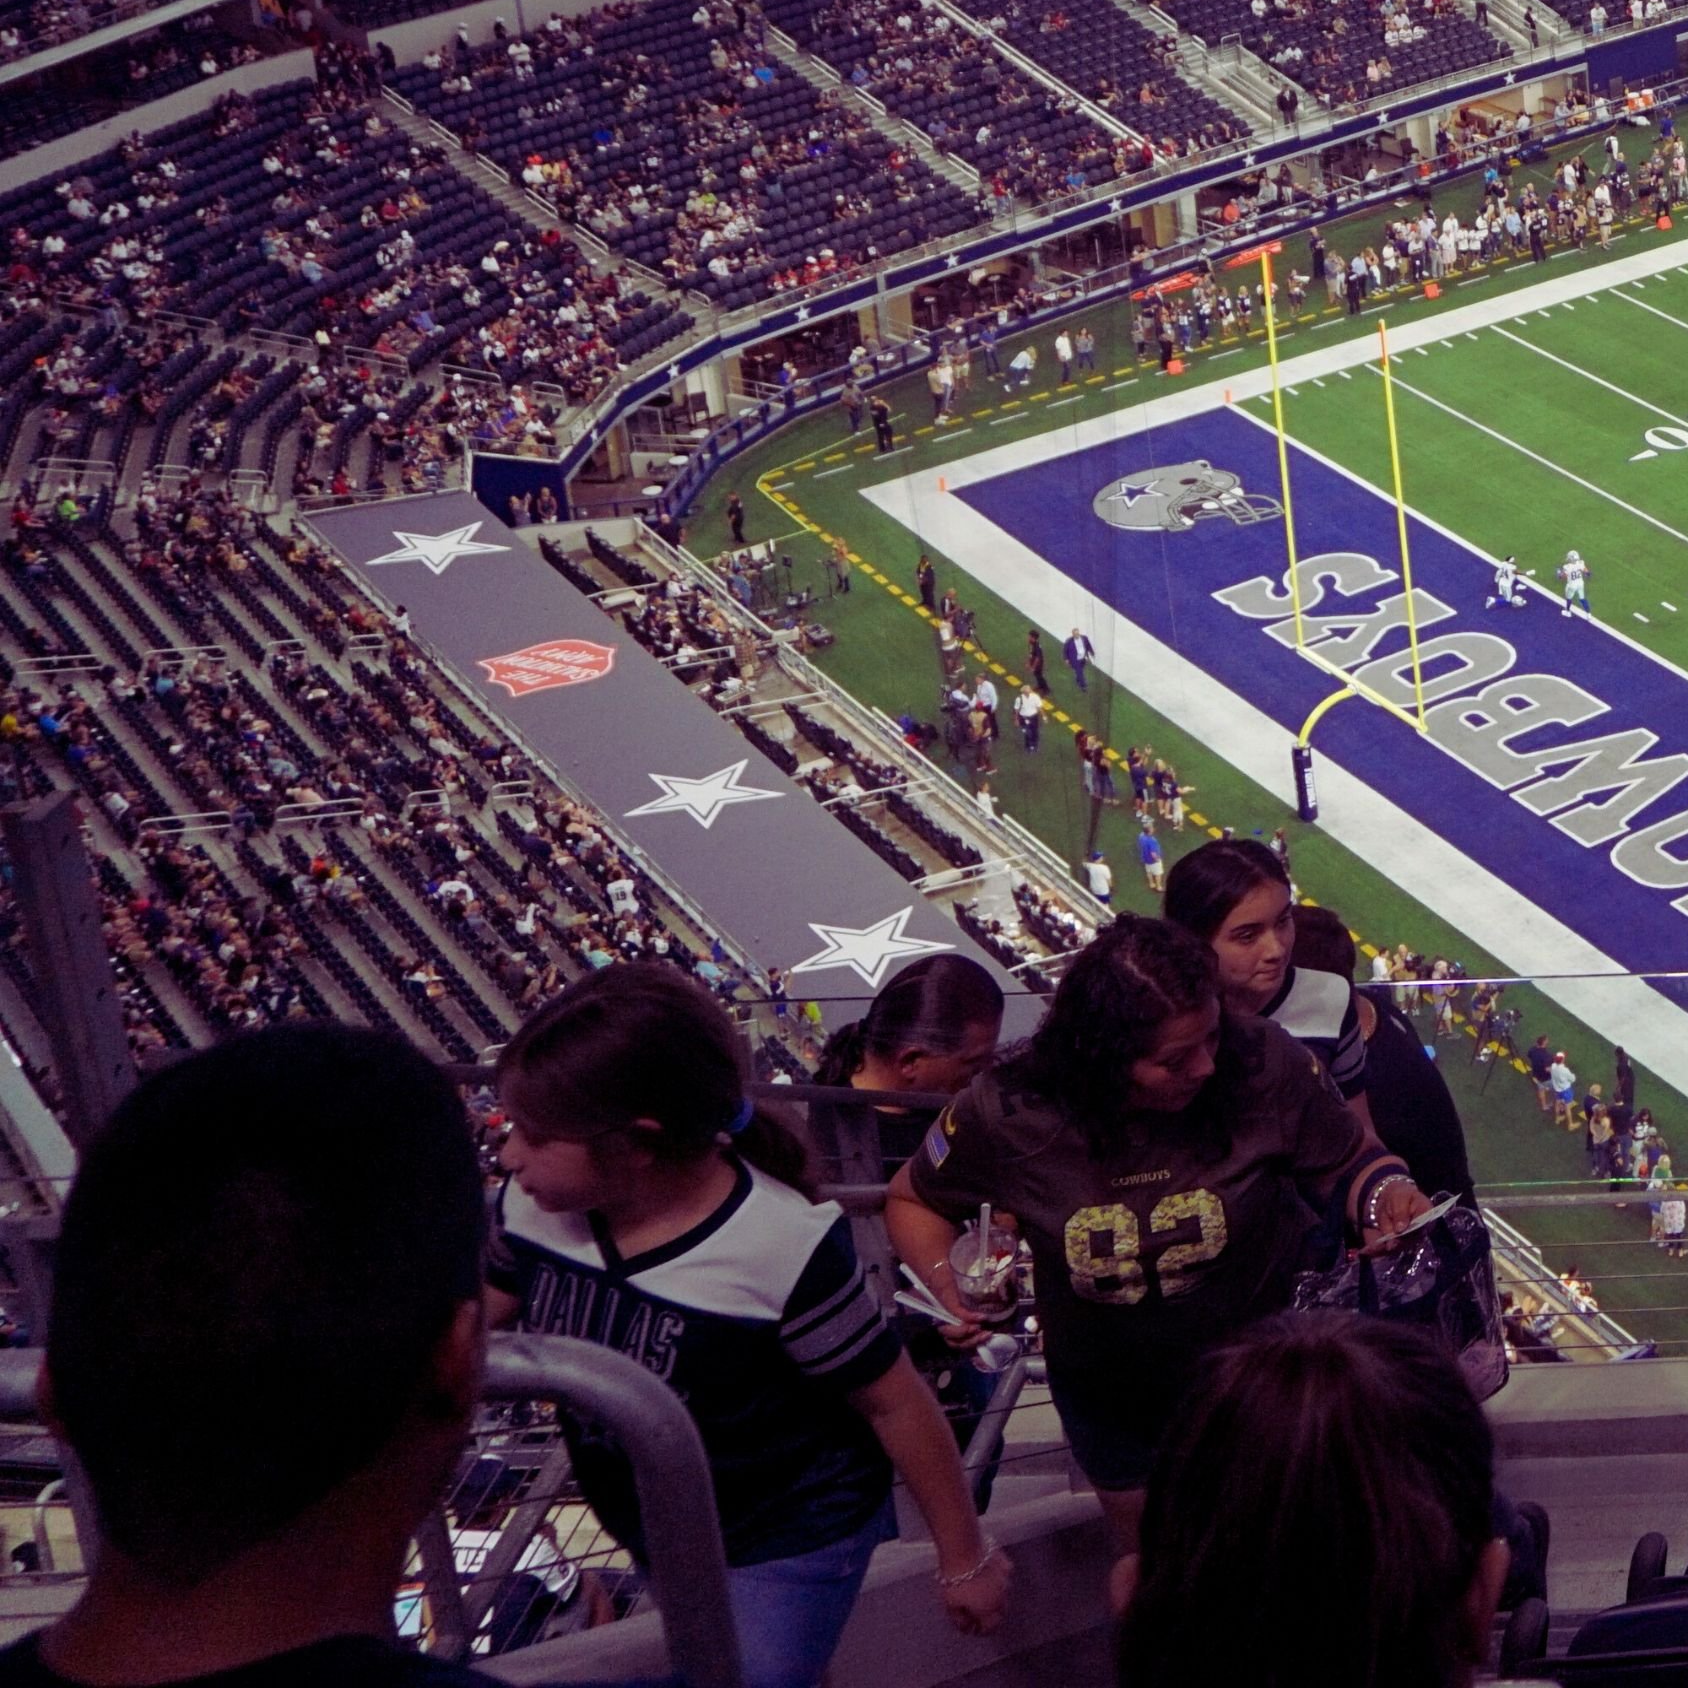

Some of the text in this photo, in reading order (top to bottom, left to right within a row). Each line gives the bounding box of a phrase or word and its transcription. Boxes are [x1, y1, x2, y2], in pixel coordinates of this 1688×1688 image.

[1111, 1168, 1171, 1188] COWBOYS
[1063, 1187, 1228, 1305] 82
[528, 1260, 685, 1382] DALLAS
